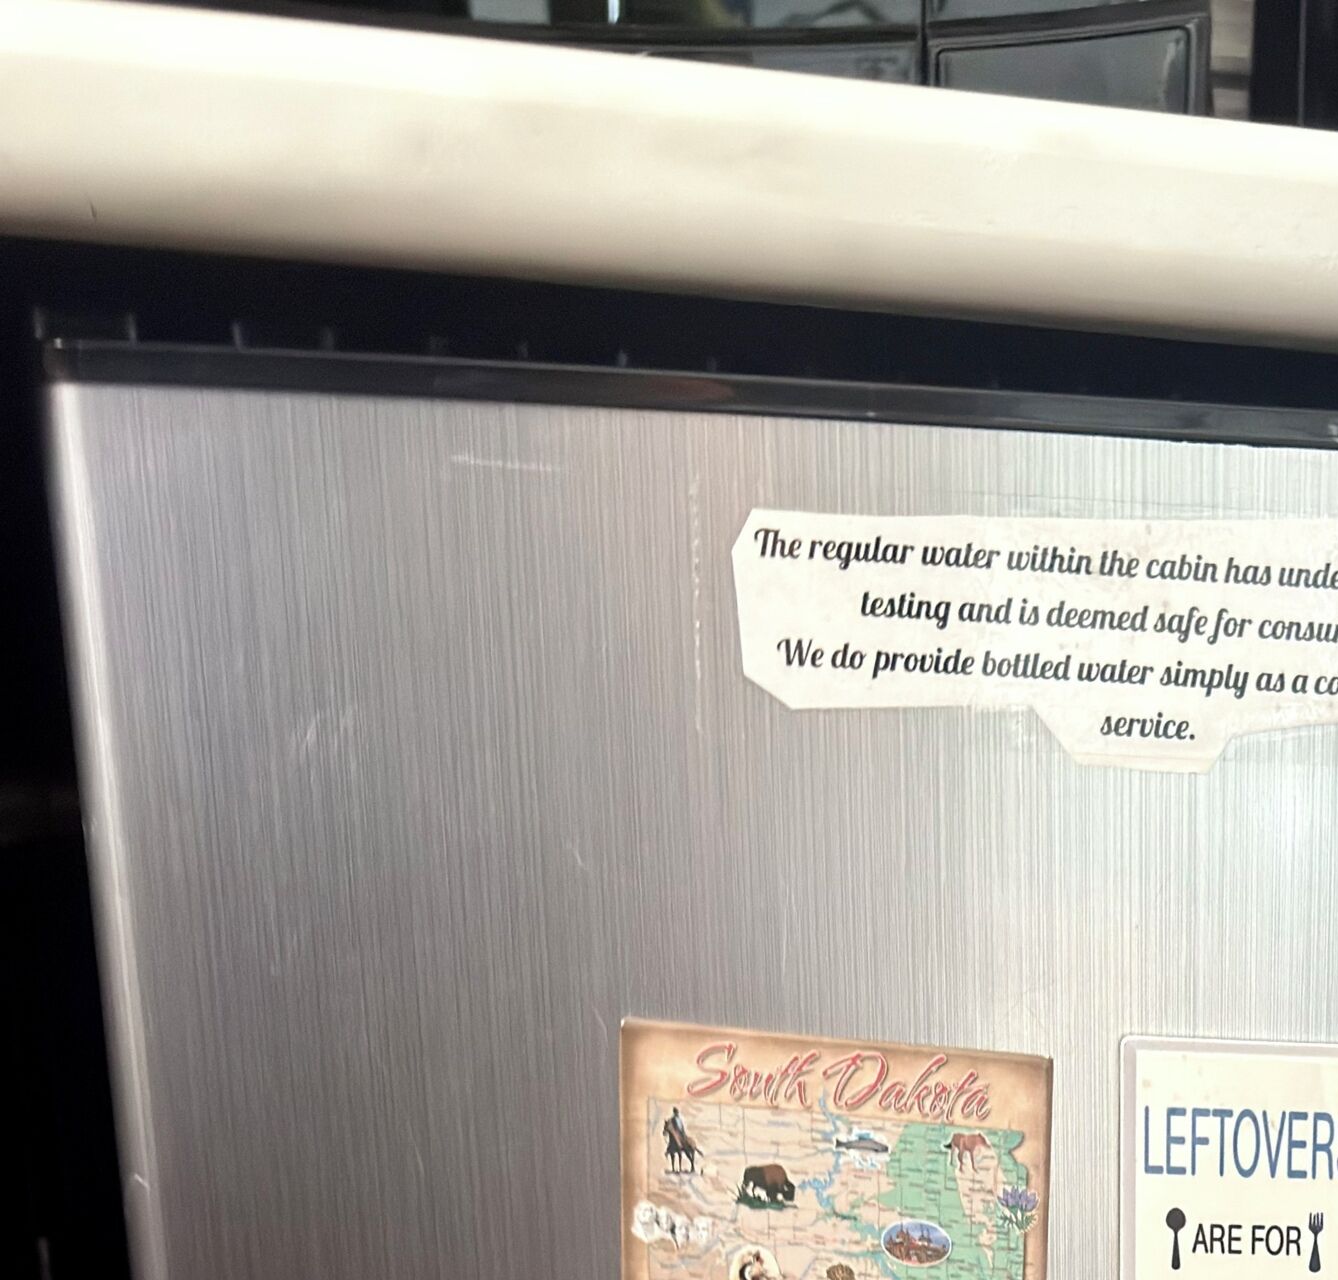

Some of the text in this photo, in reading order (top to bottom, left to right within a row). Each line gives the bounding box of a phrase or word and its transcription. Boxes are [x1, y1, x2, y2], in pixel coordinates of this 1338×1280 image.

[754, 528, 802, 559] The
[808, 536, 915, 570] regular
[921, 543, 1000, 569] water
[1007, 545, 1092, 575] within
[1100, 550, 1139, 578] the
[1146, 554, 1218, 583] cabin
[1224, 557, 1272, 586] has
[860, 591, 951, 630] testing
[958, 598, 1013, 625] and
[1018, 598, 1040, 626] is
[1046, 601, 1149, 632] deemed
[1154, 606, 1208, 643] safe
[1207, 608, 1252, 645] for
[777, 638, 824, 668] We
[831, 643, 866, 670] do
[872, 648, 975, 679] provide
[982, 651, 1071, 681] bottled
[1077, 659, 1154, 685] water
[1160, 661, 1249, 699] simply
[1256, 672, 1285, 693] as
[1291, 674, 1308, 694] a
[1100, 712, 1196, 741] service.
[687, 1041, 992, 1123] South Dakota
[1192, 1224, 1301, 1256] ARE FOR
